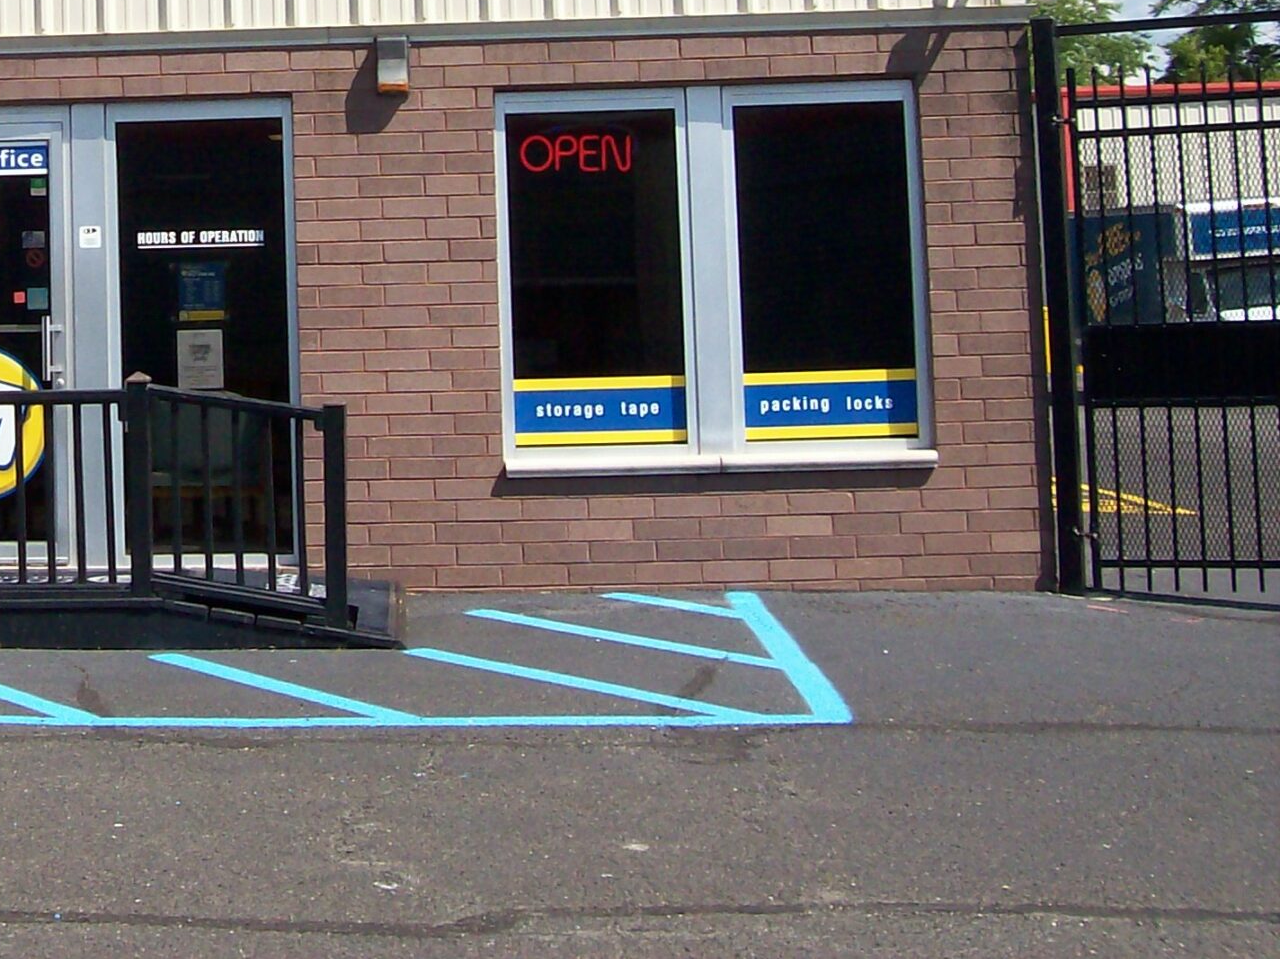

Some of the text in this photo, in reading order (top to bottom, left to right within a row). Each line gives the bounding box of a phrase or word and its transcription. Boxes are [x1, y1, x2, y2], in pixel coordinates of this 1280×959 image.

[520, 135, 631, 172] OPEN
[137, 229, 264, 244] HOURS OF OPERATION
[536, 401, 659, 419] storage tape
[760, 395, 893, 415] packing locks
